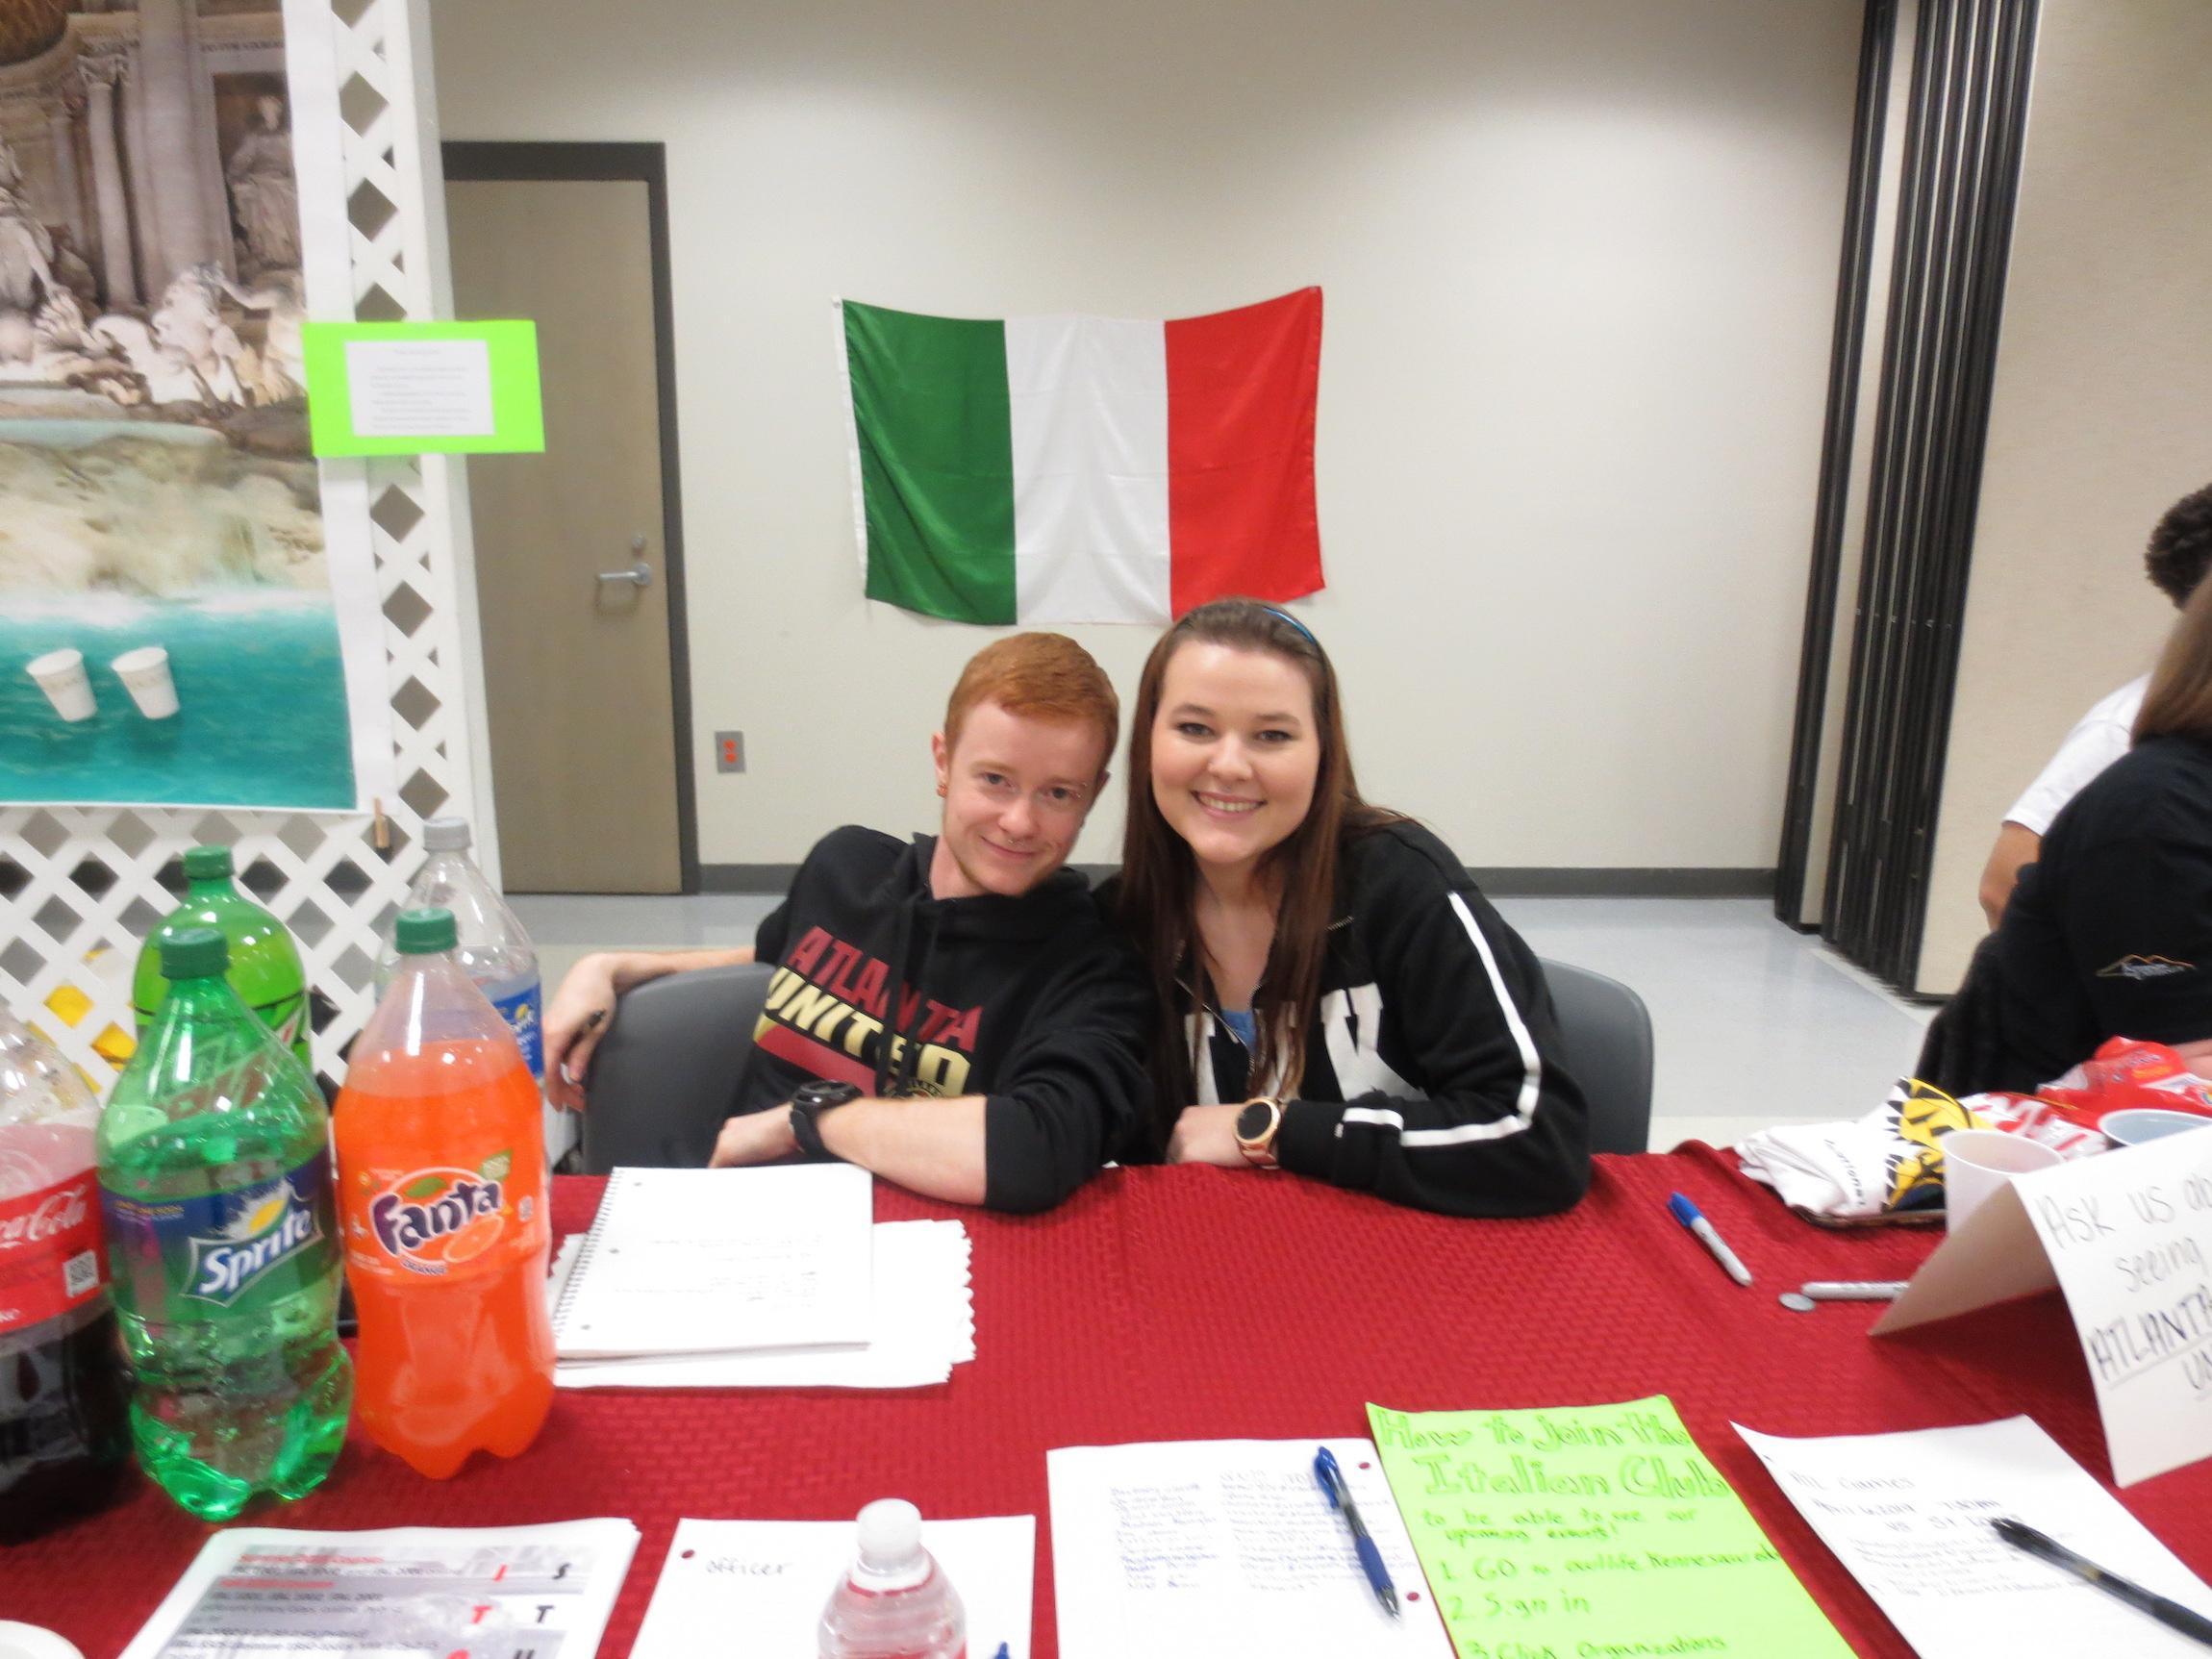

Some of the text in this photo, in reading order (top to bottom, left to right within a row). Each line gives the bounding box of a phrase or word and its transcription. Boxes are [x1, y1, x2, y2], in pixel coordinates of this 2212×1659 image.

[370, 1180, 502, 1257] Fanta
[198, 1202, 313, 1295] Sprite
[1376, 1408, 1472, 1449] How
[1532, 1414, 1623, 1451] Join
[1411, 1453, 1732, 1499] Italian Club
[1512, 1507, 1565, 1525] able
[1560, 1588, 1591, 1614] in
